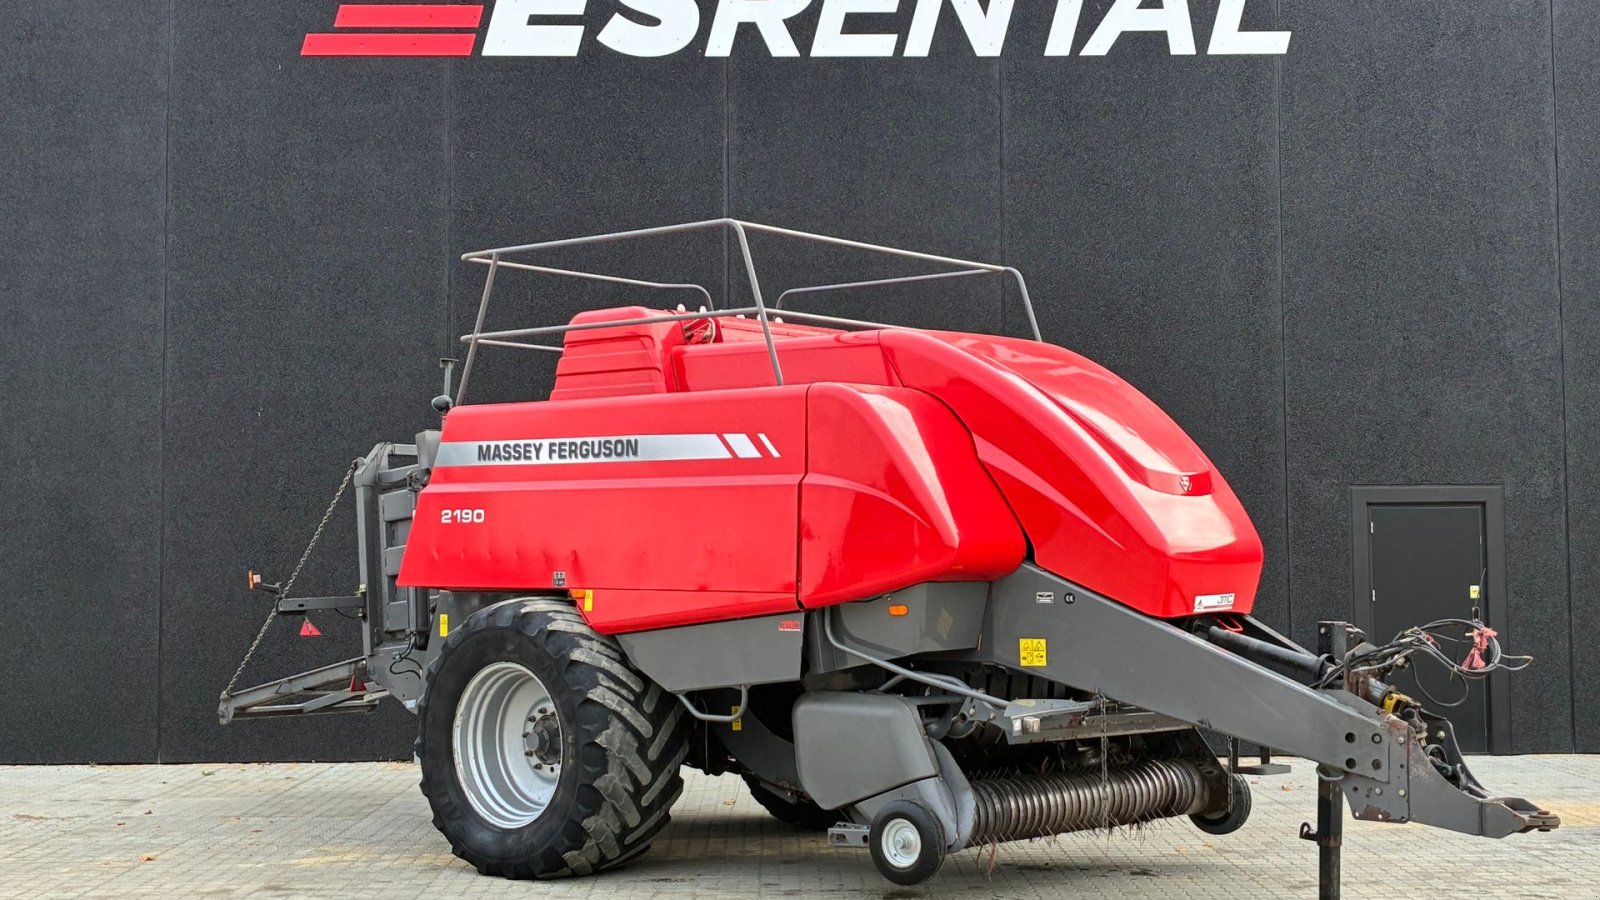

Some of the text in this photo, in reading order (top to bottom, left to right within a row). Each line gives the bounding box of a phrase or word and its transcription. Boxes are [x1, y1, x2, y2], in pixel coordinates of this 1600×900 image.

[477, 438, 639, 461] MASSEY FERGUSON
[441, 509, 485, 523] 2190
